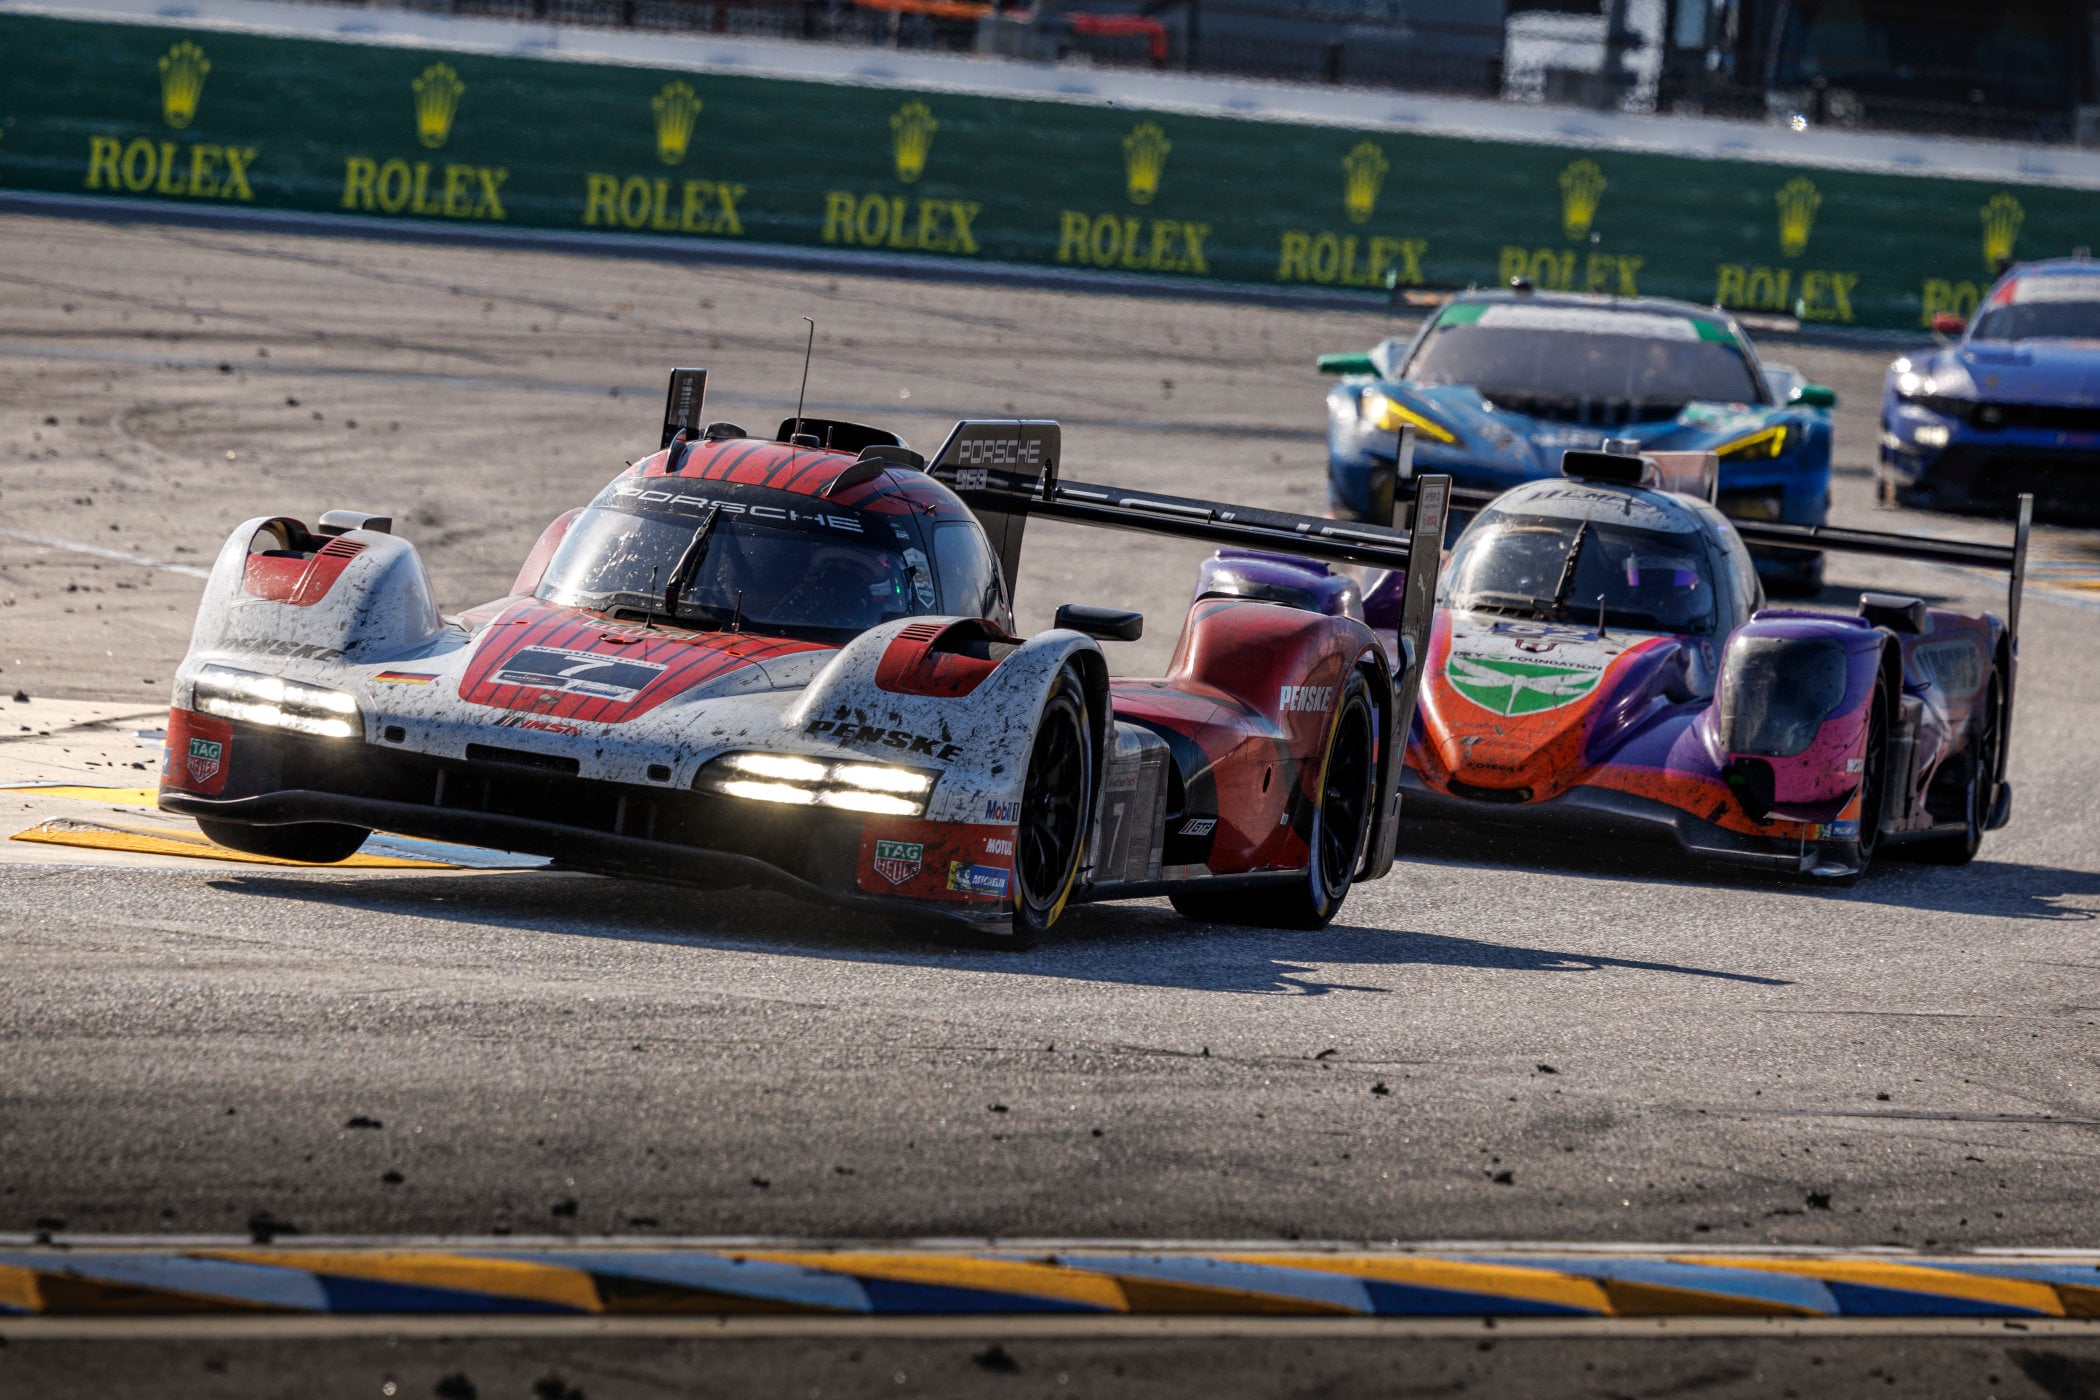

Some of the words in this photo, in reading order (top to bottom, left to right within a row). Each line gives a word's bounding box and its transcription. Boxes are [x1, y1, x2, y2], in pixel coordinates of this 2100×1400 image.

[86, 136, 256, 200] ROLEX
[342, 157, 508, 220] ROLEX
[584, 173, 746, 236] ROLEX
[822, 191, 981, 254] ROLEX
[1057, 209, 1212, 273] ROLEX
[1275, 229, 1428, 286] ROLEX
[1716, 264, 1861, 322] ROLEX
[958, 440, 1042, 464] PORSCHE
[955, 469, 988, 490] 963
[615, 487, 865, 534] PORSCHE
[557, 655, 616, 677] 7
[1453, 650, 1484, 658] DKY
[1508, 655, 1602, 671] FOUNDATION
[1279, 685, 1333, 712] PENSKE
[192, 741, 219, 759] TAG
[803, 719, 965, 763] PENSKE
[986, 800, 1012, 820] Mobil
[1012, 802, 1021, 822] 1
[881, 843, 919, 859] TAG
[986, 838, 1012, 856] MOTUL
[1107, 802, 1126, 869] 7
